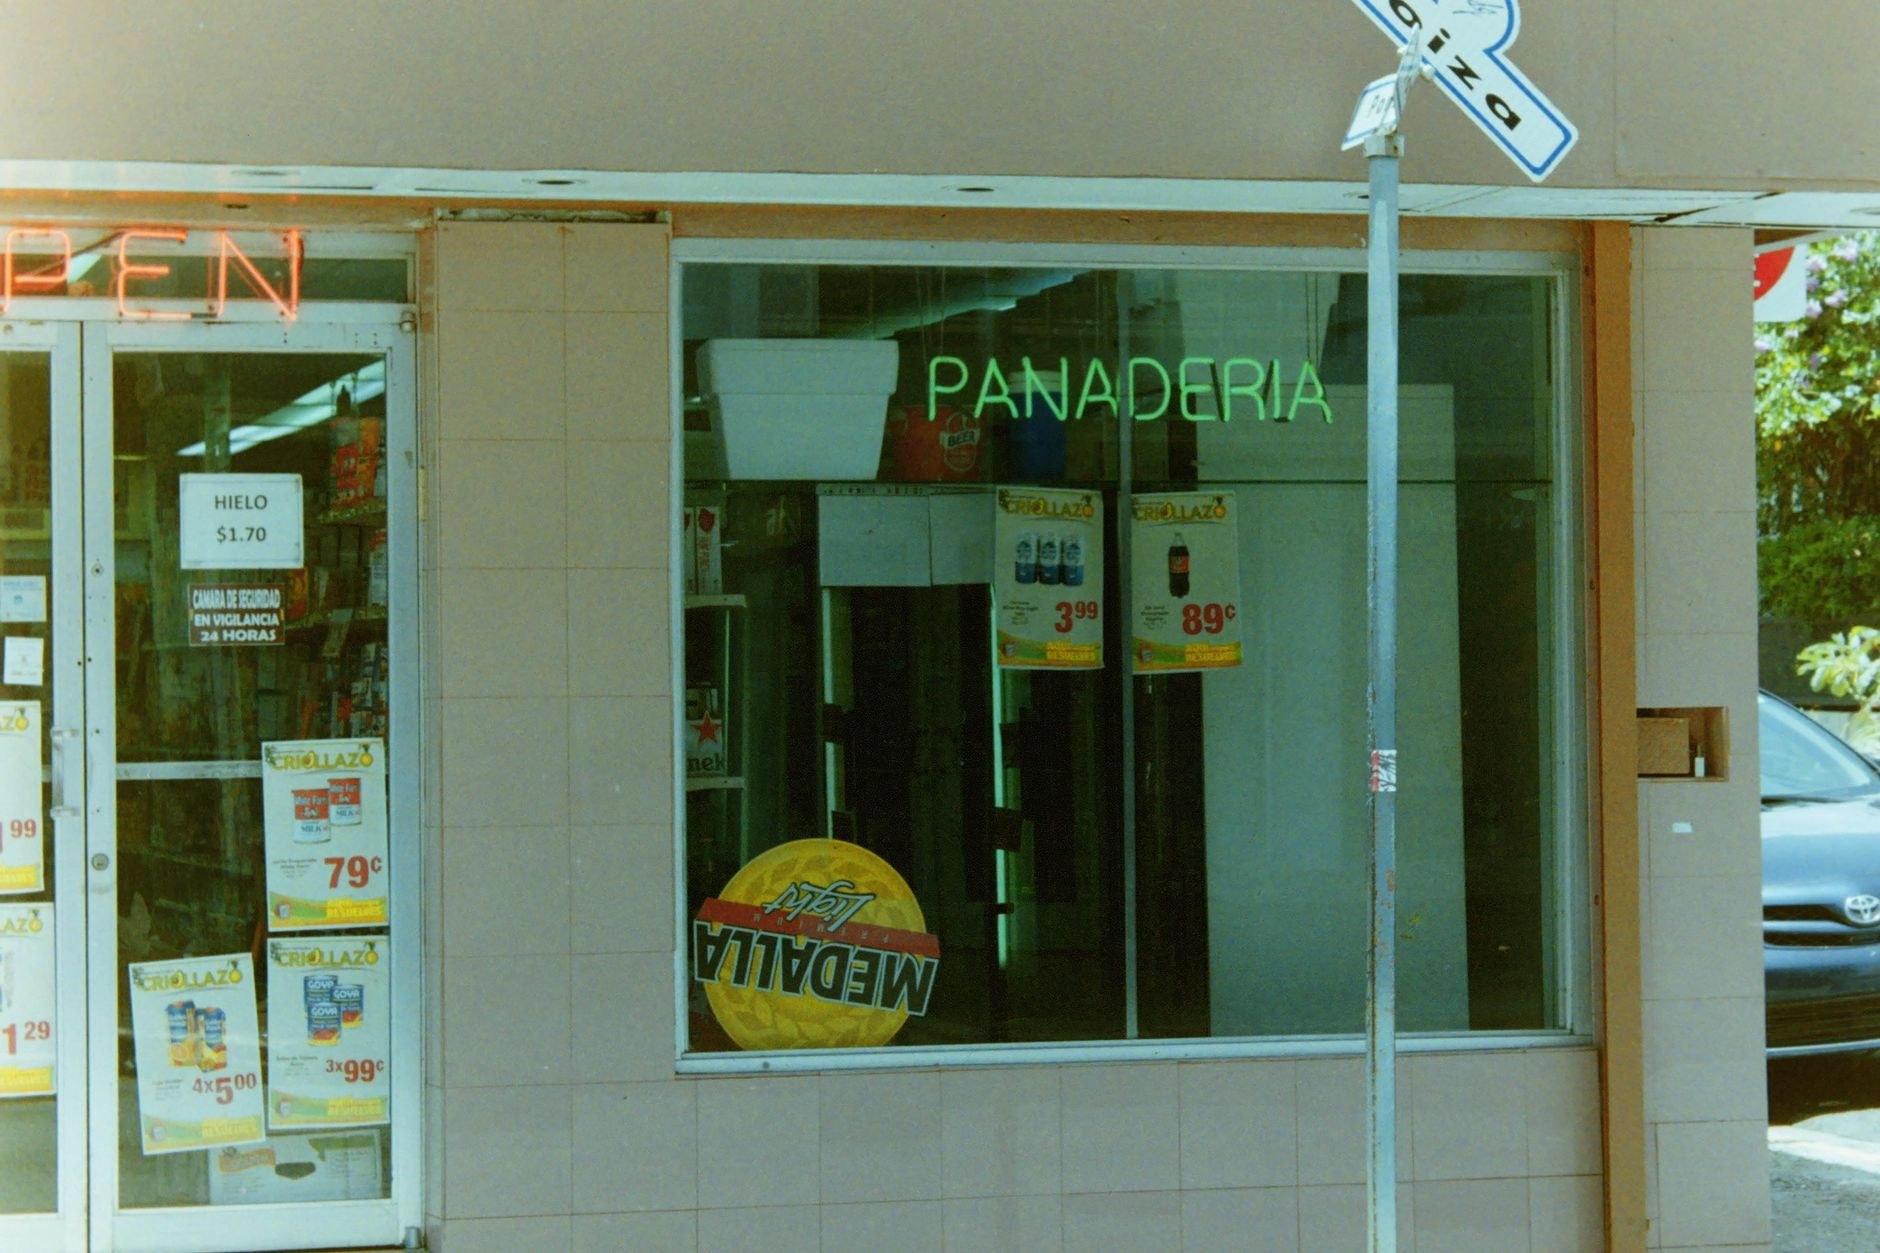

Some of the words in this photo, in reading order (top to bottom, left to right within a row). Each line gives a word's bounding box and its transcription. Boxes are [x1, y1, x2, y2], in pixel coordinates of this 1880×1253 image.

[928, 356, 1334, 424] PANADERIA
[948, 430, 976, 447] BEER
[213, 493, 269, 511] HIELO
[1006, 495, 1095, 519] CRIOLLAZO
[1133, 499, 1227, 522] CRIOLLAZO
[215, 525, 268, 544] $1.70
[192, 588, 226, 609] CAMARA
[226, 588, 238, 609] DE
[238, 588, 281, 609] SEGURIDAD
[193, 613, 211, 627] EN
[212, 613, 280, 627] VIGILANCIA
[200, 630, 219, 642] 24
[222, 629, 277, 642] HORAS
[271, 747, 375, 772] CRIOLLAZO
[324, 855, 383, 890] 79¢
[761, 880, 877, 934] Light
[277, 945, 380, 970] CRIOLLAZO
[692, 919, 940, 1017] MEDALLA
[140, 965, 244, 993] CRIOLLAZO
[332, 989, 360, 999] GOYA
[311, 1006, 338, 1016] GOYA
